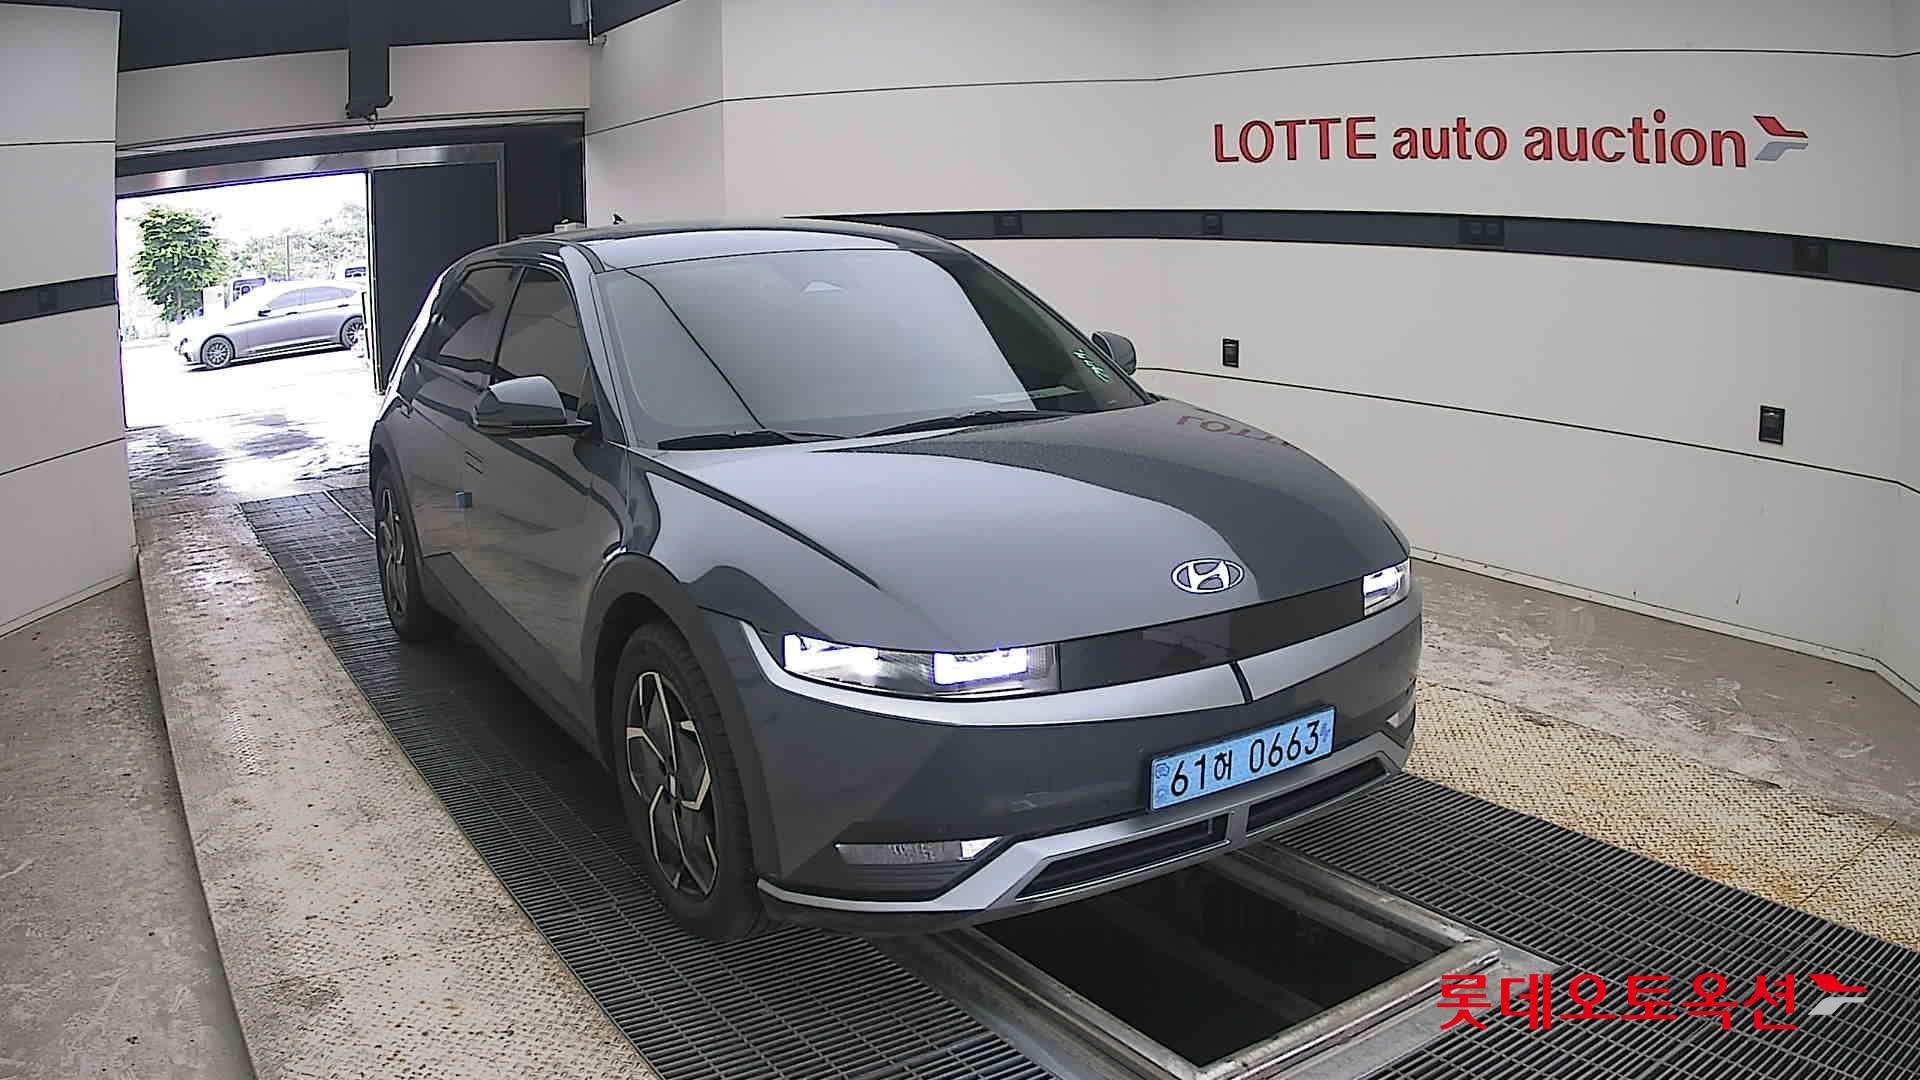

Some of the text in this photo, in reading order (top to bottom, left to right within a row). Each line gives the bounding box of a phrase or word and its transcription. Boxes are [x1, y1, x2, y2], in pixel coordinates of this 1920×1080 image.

[1213, 109, 1749, 168] LOTTE auto auction
[1249, 719, 1320, 773] 0663
